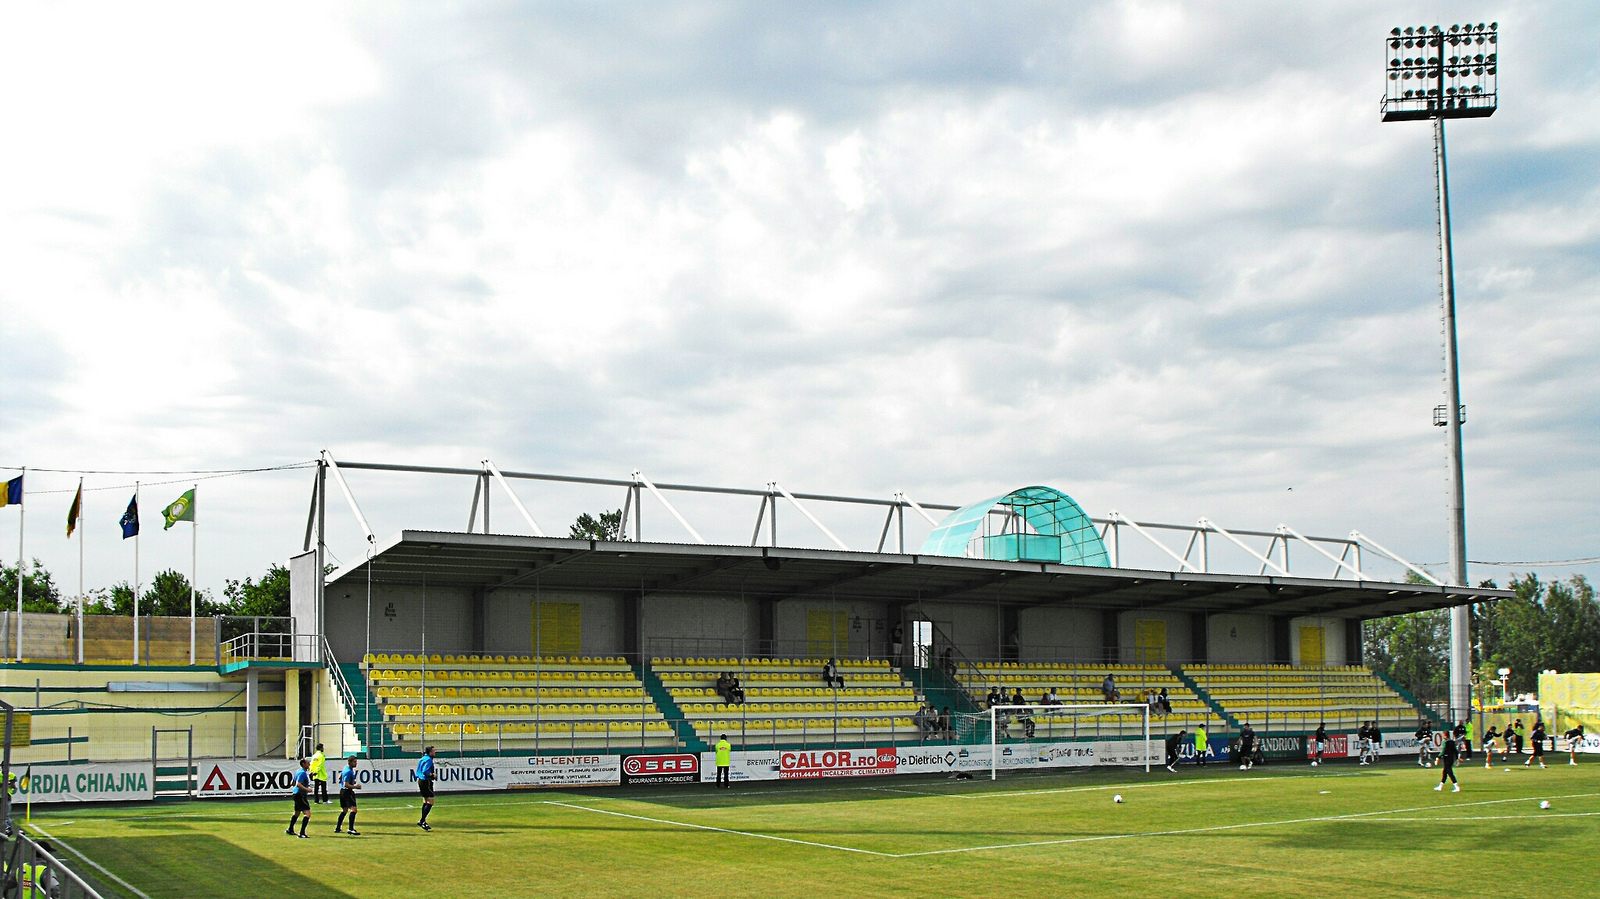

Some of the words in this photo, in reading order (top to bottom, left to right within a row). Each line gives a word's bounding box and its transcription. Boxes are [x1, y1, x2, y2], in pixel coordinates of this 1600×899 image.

[1258, 737, 1300, 751] ANDRION
[528, 756, 600, 766] CH-CENTER
[645, 759, 693, 770] SAS
[781, 751, 876, 769] CALOR.RO
[909, 754, 943, 766] Dietrich
[409, 767, 494, 783] MUNILOR
[12, 773, 71, 795] ORDIA
[76, 772, 148, 793] CHIAJNA
